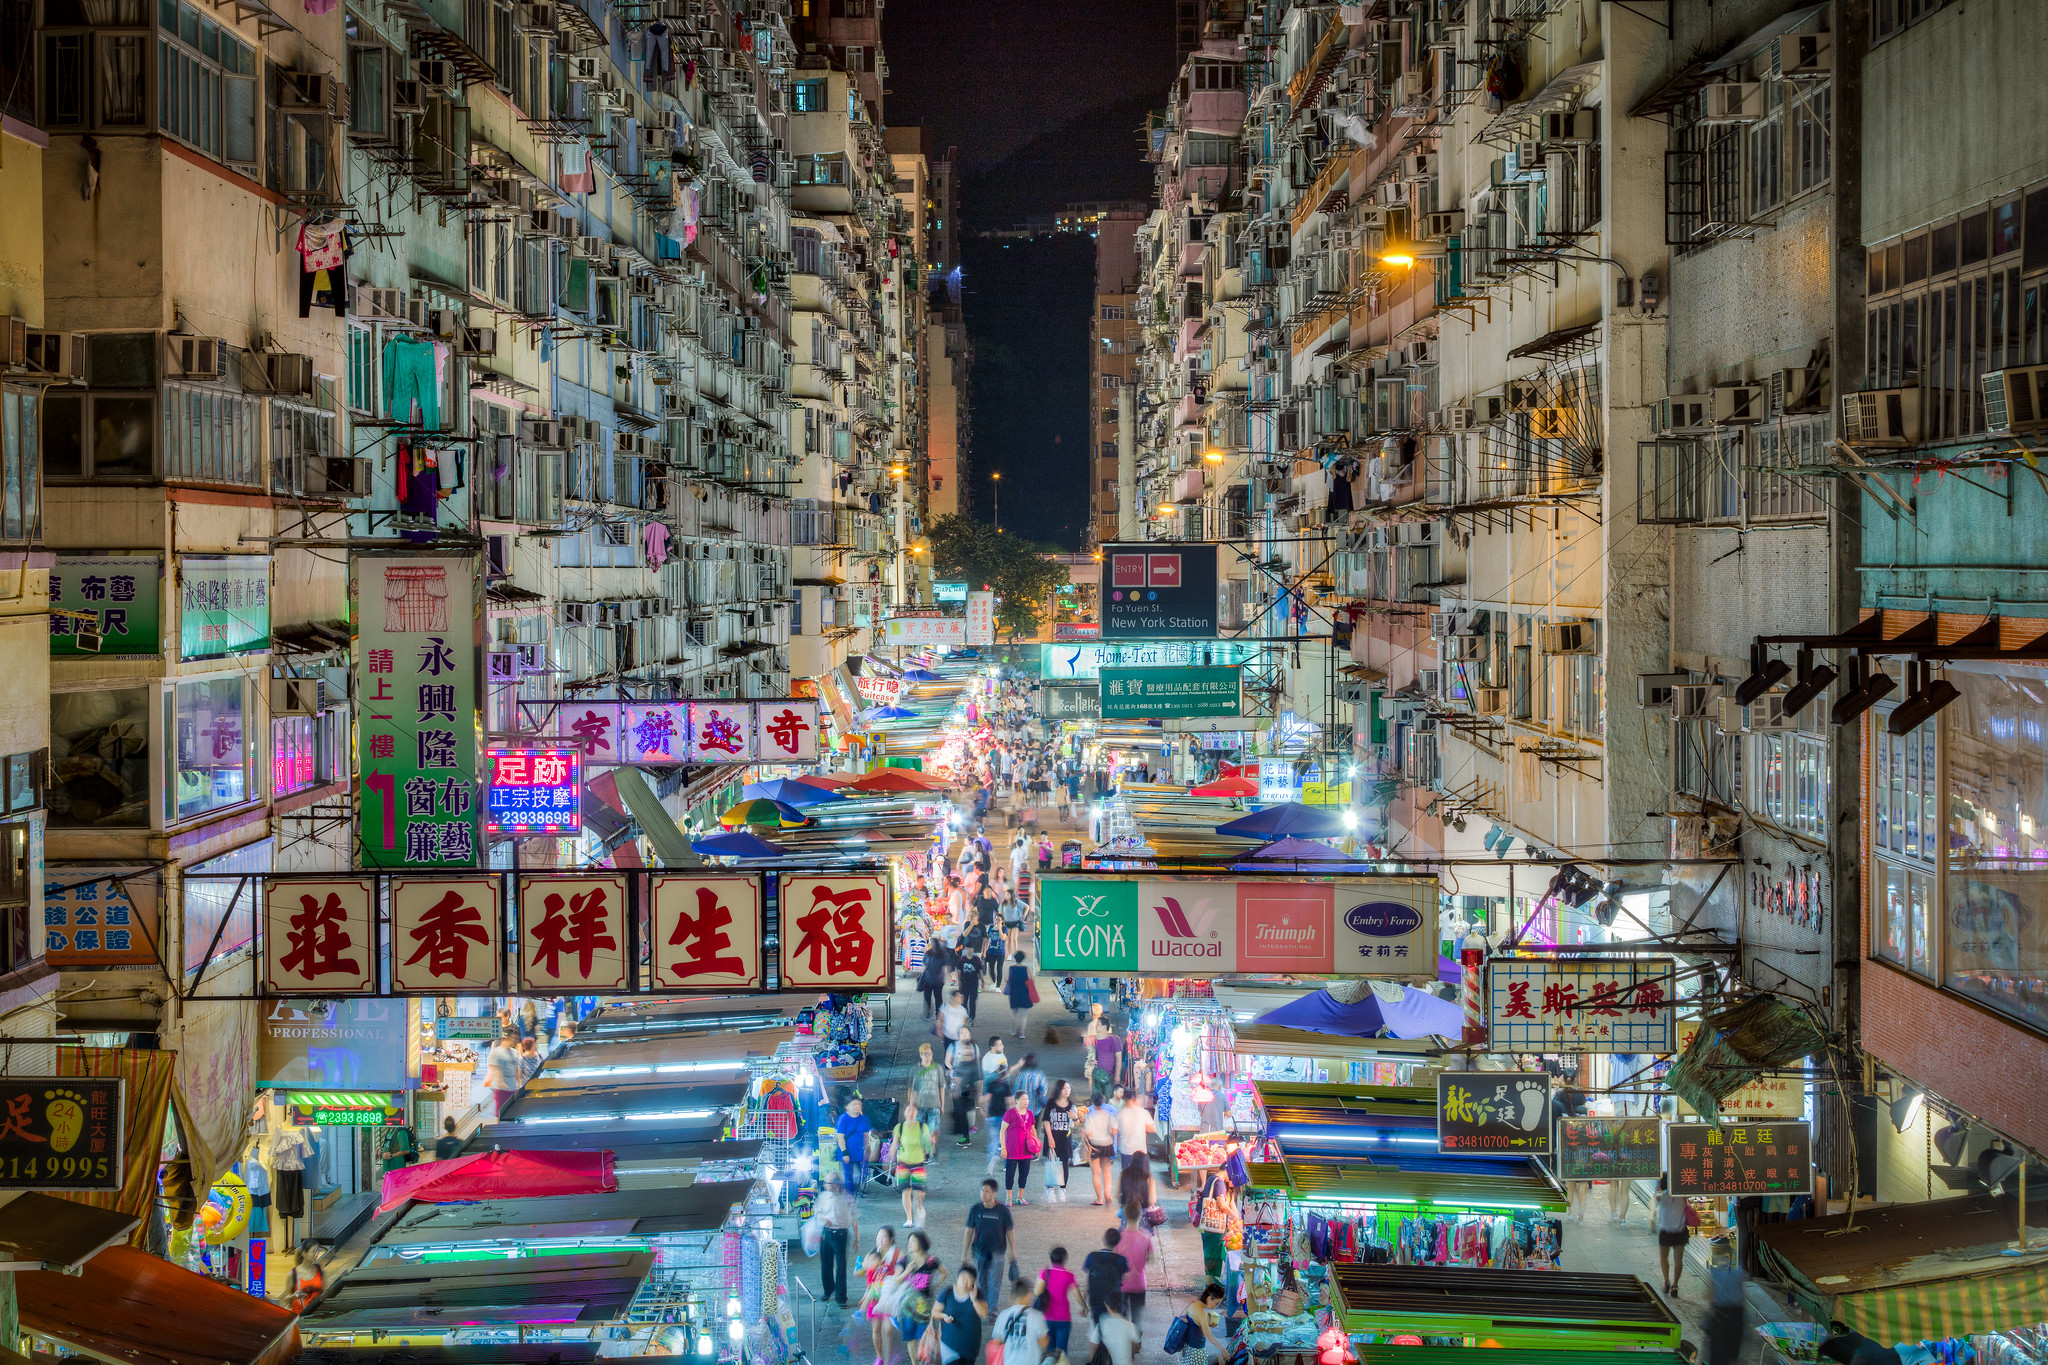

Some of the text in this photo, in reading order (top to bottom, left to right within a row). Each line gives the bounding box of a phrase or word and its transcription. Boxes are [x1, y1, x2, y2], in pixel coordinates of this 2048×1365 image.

[1115, 565, 1143, 574] ENTRY
[183, 578, 266, 613] 永興隆窗簾布藝
[1112, 603, 1162, 612] Fa Yuen St.
[904, 621, 963, 635] 實惠窗簾
[1111, 616, 1209, 628] New York Station
[1094, 644, 1158, 664] Home-Text
[1146, 681, 1237, 692] 醫療用品配套有限公司
[368, 649, 395, 758] 請上一樓
[859, 690, 895, 702] Suitcase
[1205, 740, 1237, 749] 日麗布藝
[495, 757, 567, 785] 足跡
[1262, 776, 1289, 788] 布藝
[491, 787, 571, 808] 正宗按摩
[1352, 915, 1415, 928] Embry Form
[46, 930, 132, 951] 心保證
[1055, 923, 1126, 958] LEONA
[1255, 923, 1316, 943] Triumph
[1151, 939, 1222, 958] Wacoal
[1358, 944, 1409, 957] 安莉芳
[273, 1028, 384, 1040] PROFESSIONAL
[1555, 1026, 1609, 1035] 請登二樓
[52, 1103, 76, 1119] 24
[328, 1112, 382, 1123] 2393 8698
[55, 1121, 70, 1150] 小時
[1458, 1136, 1547, 1148] 34810700 1/F
[1707, 1129, 1773, 1145] 龍足廷
[1621, 1147, 1656, 1162] Massage
[46, 1157, 109, 1179] 9995
[1680, 1142, 1698, 1186] 專業
[1702, 1181, 1800, 1191] Tel:34810700 1/F
[237, 1194, 246, 1214] Ring
